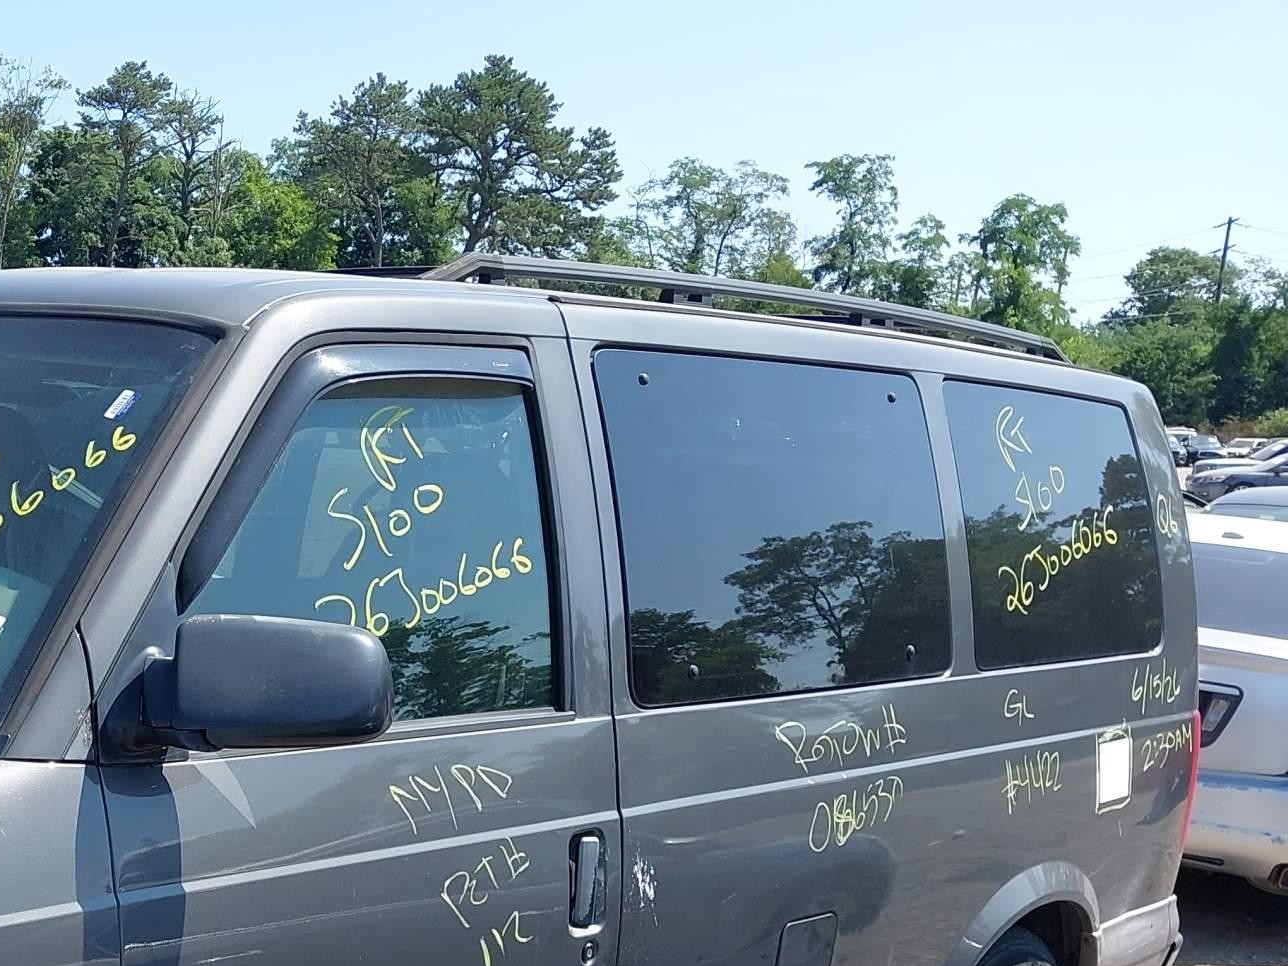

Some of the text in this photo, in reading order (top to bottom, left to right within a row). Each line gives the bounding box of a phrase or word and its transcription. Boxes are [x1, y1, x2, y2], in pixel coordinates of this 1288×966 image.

[996, 406, 1032, 472] RT
[998, 505, 1118, 615] 26J006066
[389, 764, 512, 835] NYPD
